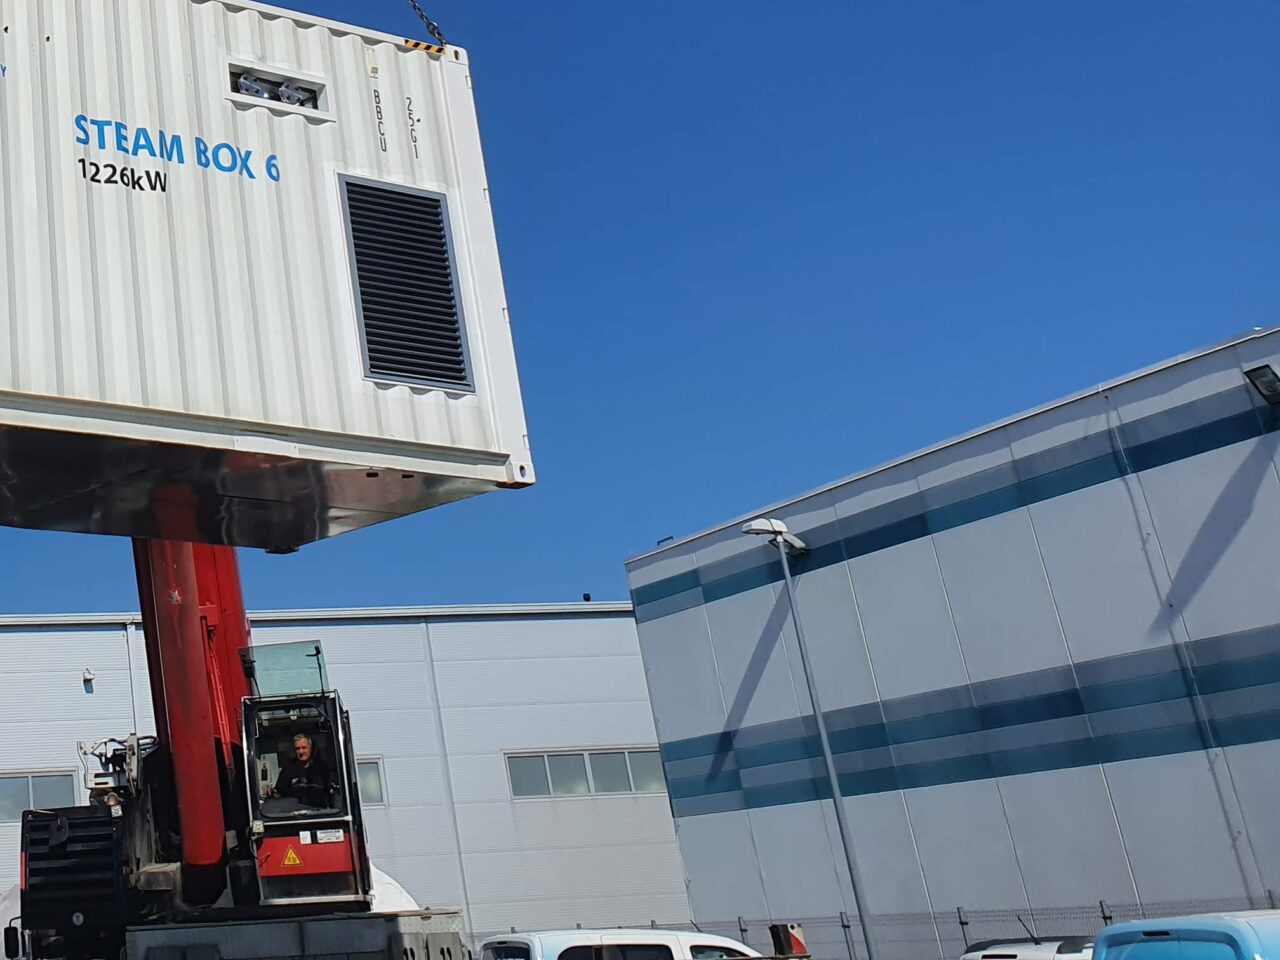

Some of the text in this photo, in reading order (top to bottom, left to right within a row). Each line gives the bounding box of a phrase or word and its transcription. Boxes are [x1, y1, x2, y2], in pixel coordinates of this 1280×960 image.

[74, 113, 280, 183] STEAM BOX 6
[373, 89, 387, 152] BBCU
[78, 158, 167, 193] 1226kW
